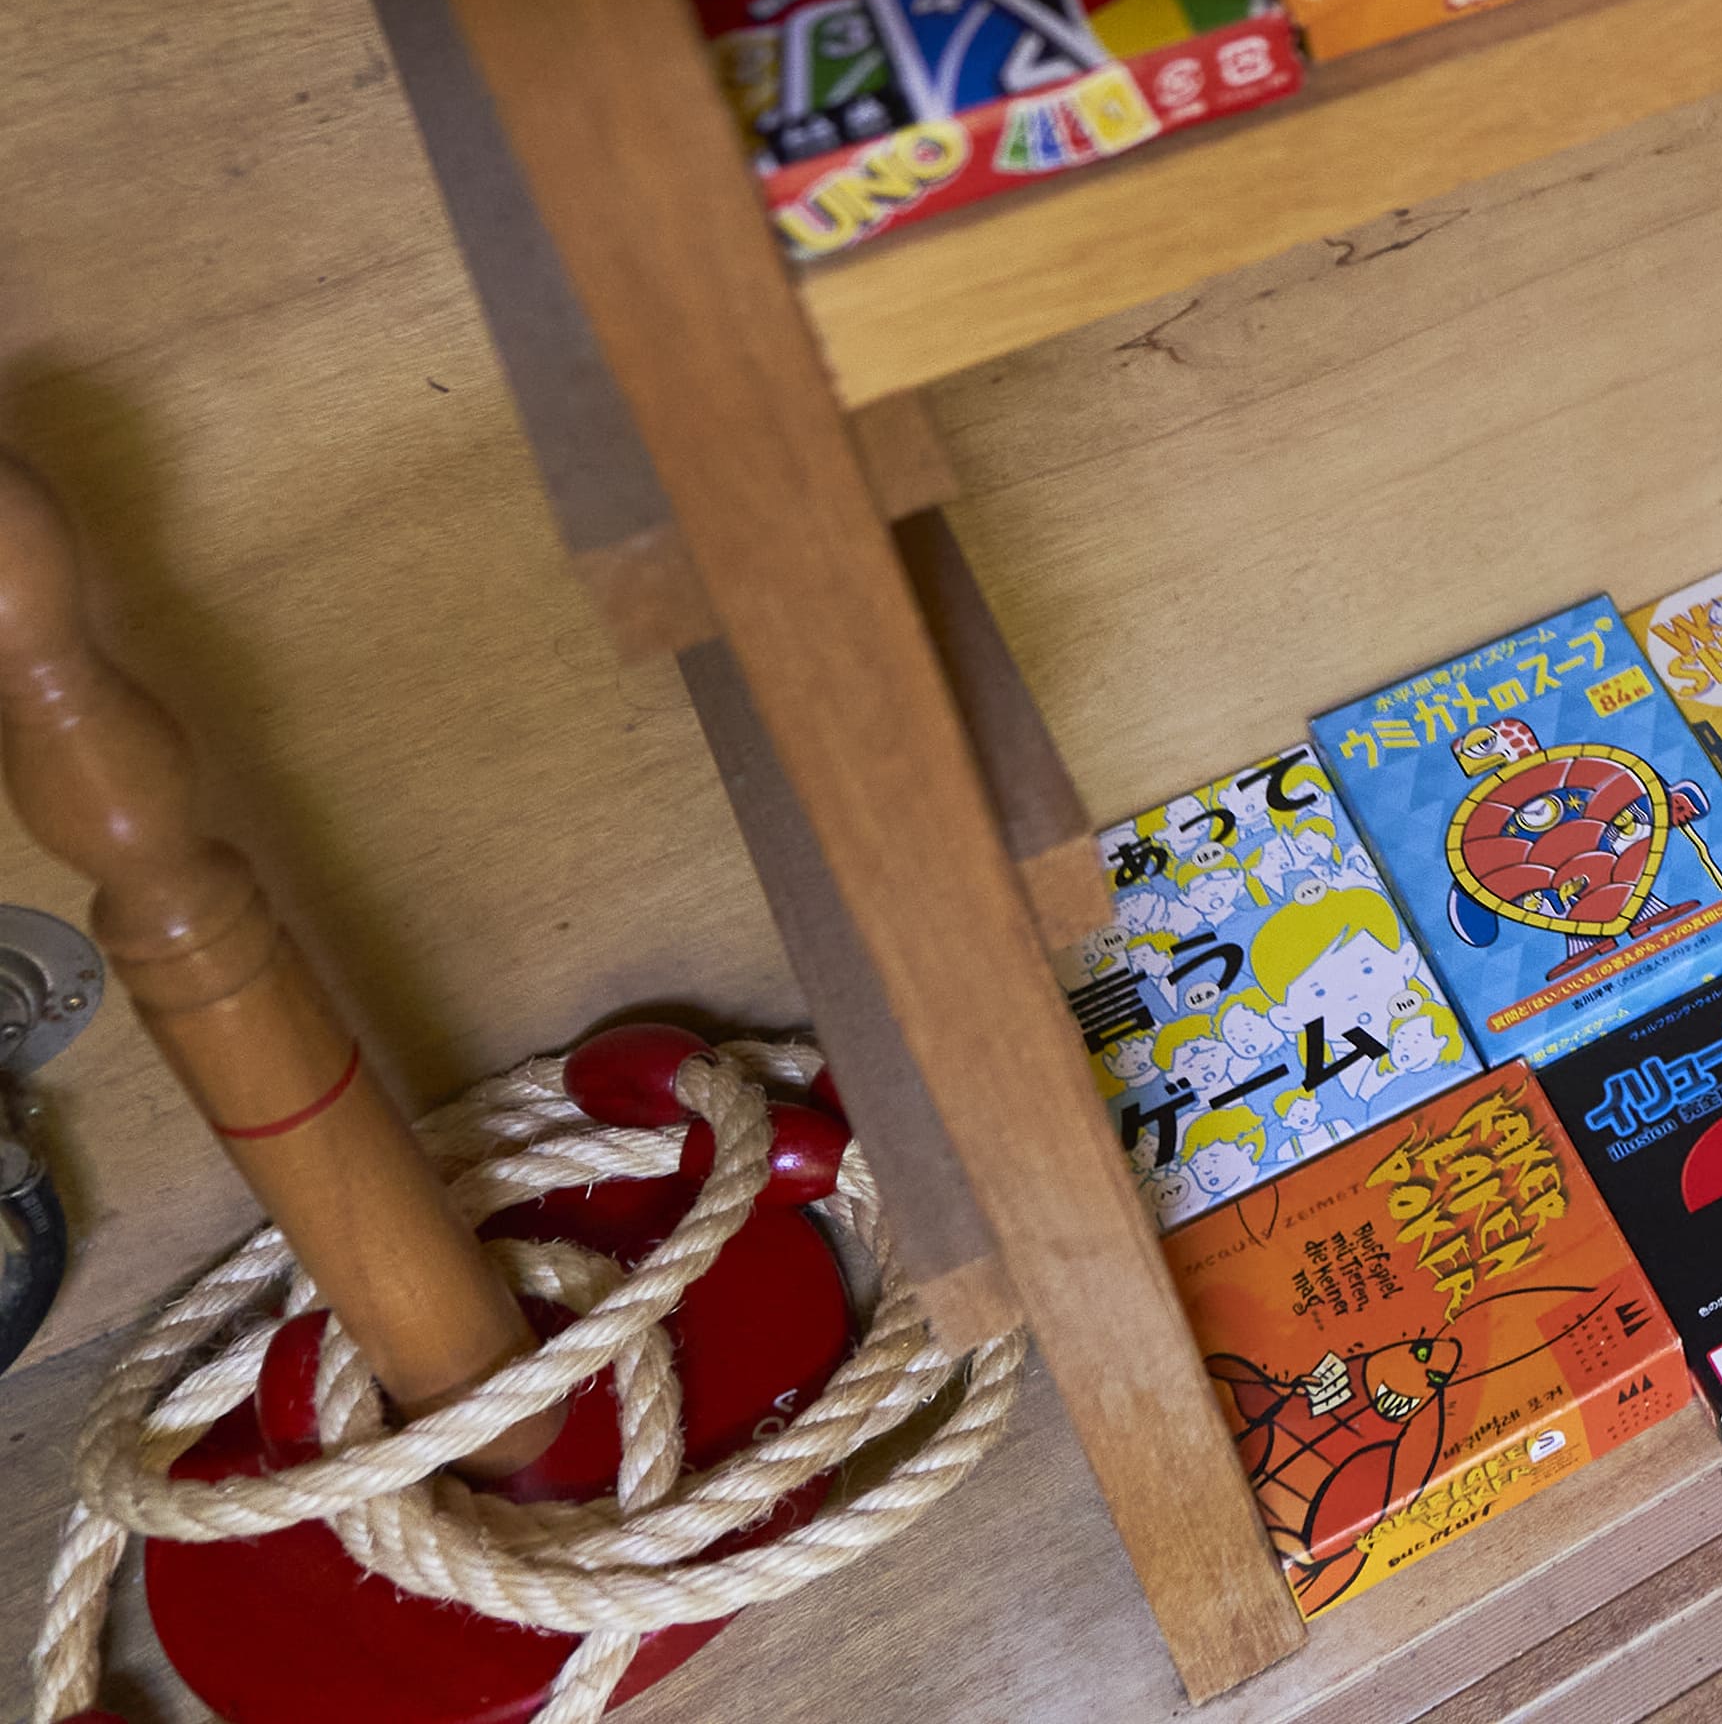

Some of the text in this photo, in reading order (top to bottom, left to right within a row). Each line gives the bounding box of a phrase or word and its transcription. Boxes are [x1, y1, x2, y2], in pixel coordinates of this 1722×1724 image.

[776, 118, 968, 258] UNO
[1339, 616, 1613, 770] ウミガメのスープ
[1102, 930, 1126, 949] ha
[1395, 994, 1418, 1013] ha
[1120, 1015, 1390, 1170] ゲーム
[1605, 1118, 1678, 1162] illusion
[1354, 1221, 1405, 1304] Bluffspiel
[1365, 1121, 1480, 1324] POKER
